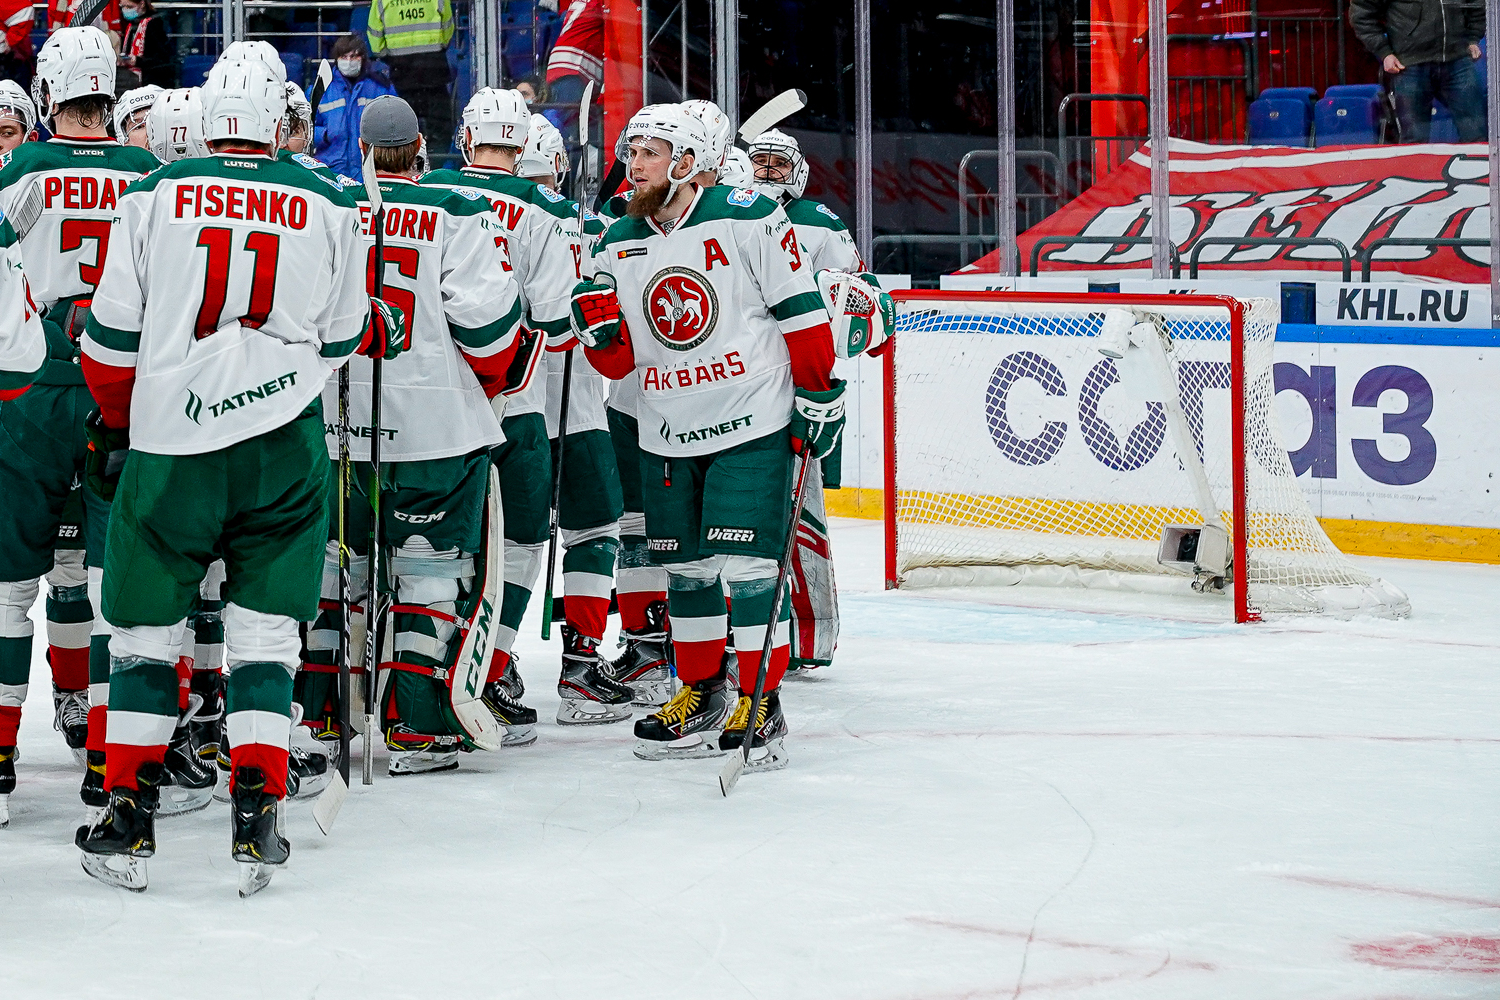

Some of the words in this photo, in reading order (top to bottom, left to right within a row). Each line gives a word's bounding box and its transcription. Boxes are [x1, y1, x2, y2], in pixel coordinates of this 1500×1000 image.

[398, 8, 425, 21] 1405
[90, 75, 99, 92] 3
[170, 126, 188, 143] 77
[226, 117, 238, 135] 11
[501, 124, 514, 139] 12
[223, 160, 258, 169] LUTCH
[174, 184, 308, 231] FISENKO
[703, 238, 730, 271] A
[193, 226, 281, 343] 11
[1336, 286, 1470, 323] KHL.RU
[676, 350, 746, 388] BARS
[207, 371, 298, 419] TATNEFT
[803, 400, 845, 418] CC
[675, 414, 753, 444] TATNEFT
[393, 509, 447, 524] CCM
[465, 596, 494, 699] CCM
